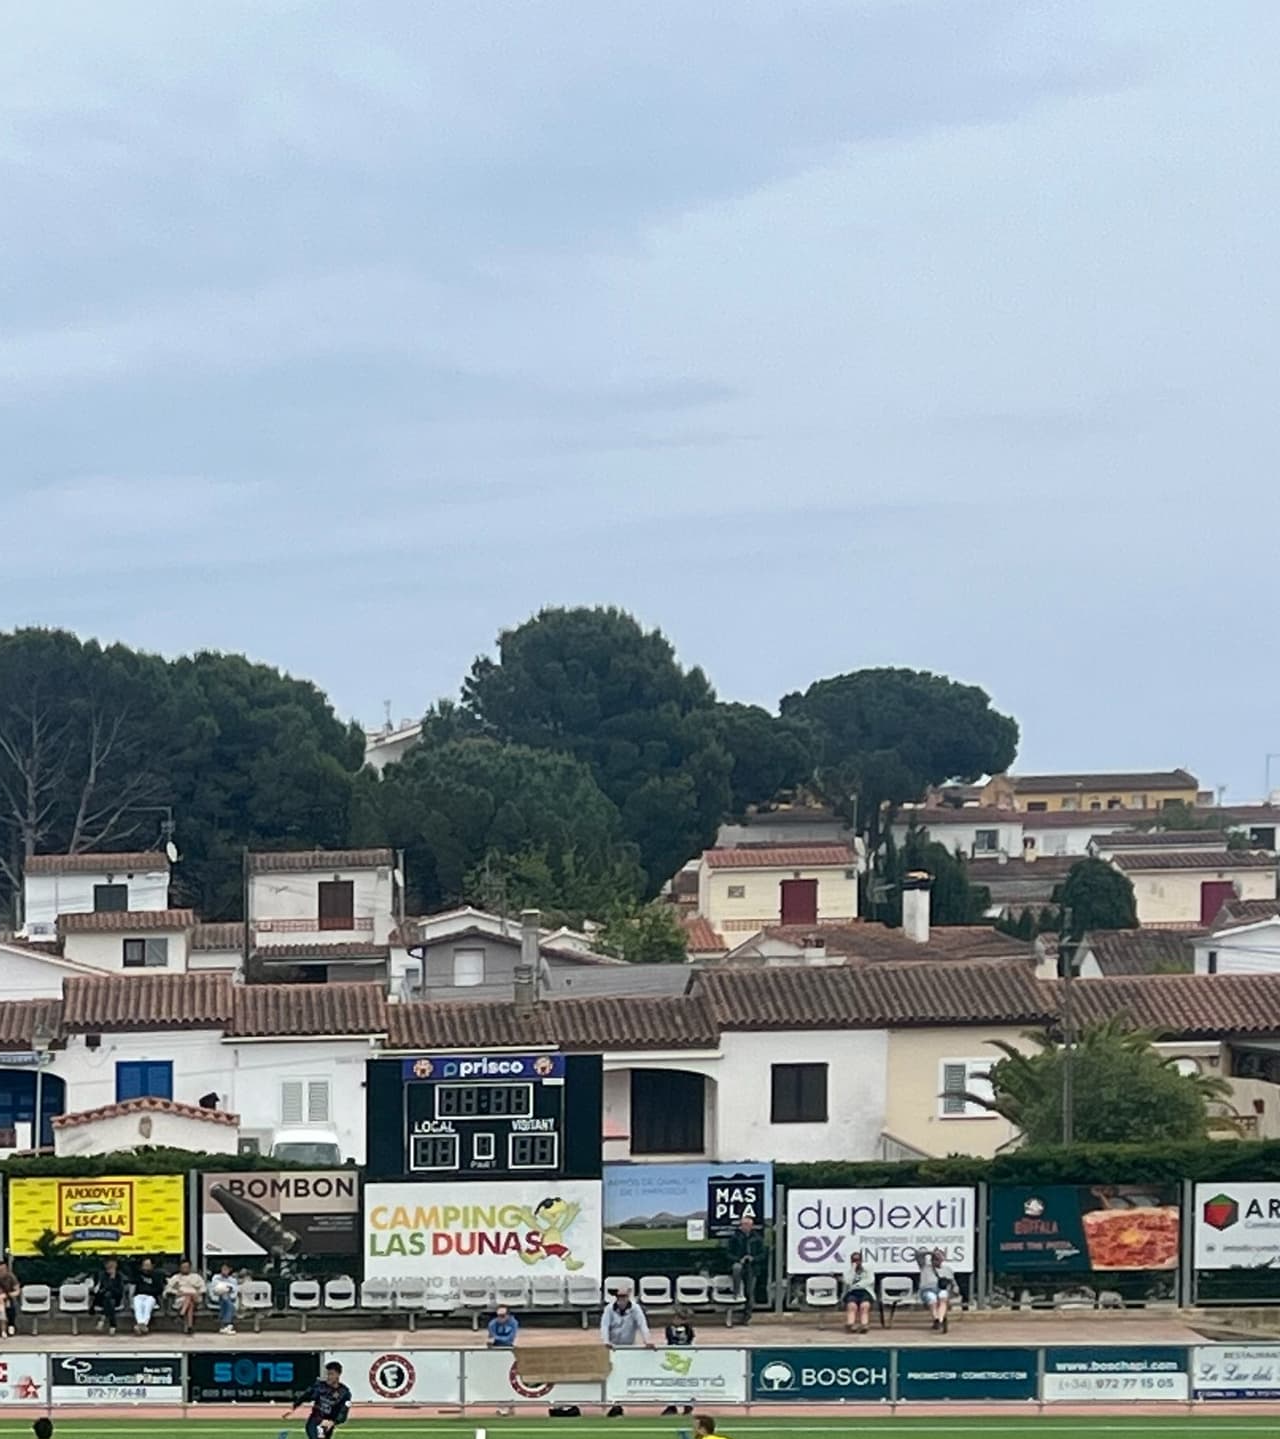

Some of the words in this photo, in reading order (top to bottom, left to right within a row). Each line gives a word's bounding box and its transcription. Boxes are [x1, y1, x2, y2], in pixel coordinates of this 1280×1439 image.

[459, 1057, 524, 1077] prisco
[413, 1120, 456, 1133] LOCAL
[511, 1118, 555, 1131] VISITANT
[64, 1187, 126, 1200] ANXOVES
[228, 1177, 354, 1199] BOMBON
[715, 1187, 757, 1203] MAS
[369, 1203, 523, 1231] CAMPING
[715, 1203, 757, 1219] PLA
[797, 1198, 966, 1235] duplextil
[65, 1214, 127, 1227] L'ESCALA
[369, 1231, 425, 1257] LAS
[431, 1230, 542, 1257] DUNAS
[859, 1246, 965, 1263] INTEGLS
[213, 1358, 294, 1386] sons
[801, 1367, 887, 1386] BOSCH
[1095, 1378, 1119, 1389] 972
[1122, 1378, 1137, 1389] 77
[1140, 1378, 1154, 1389] 15
[1157, 1378, 1174, 1389] 05
